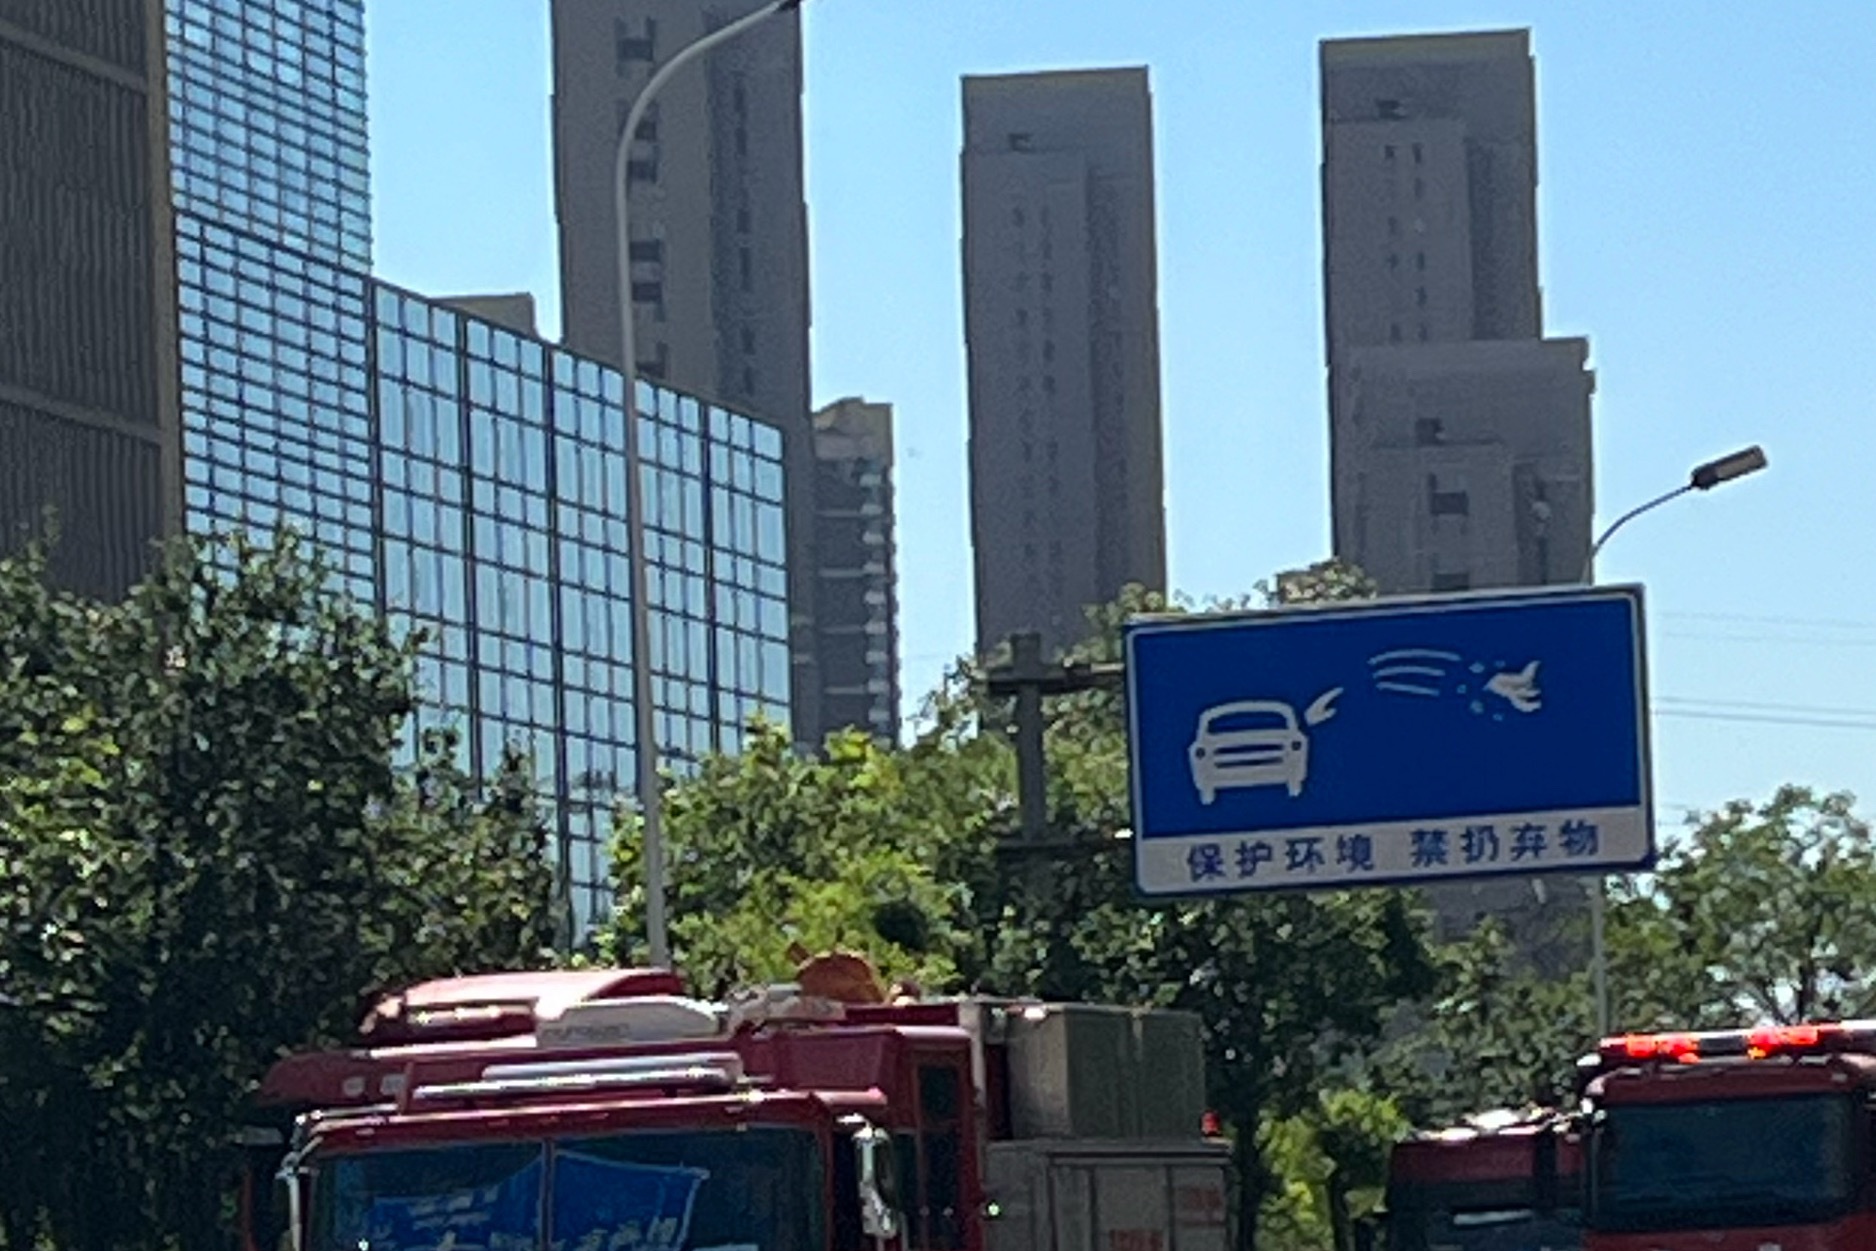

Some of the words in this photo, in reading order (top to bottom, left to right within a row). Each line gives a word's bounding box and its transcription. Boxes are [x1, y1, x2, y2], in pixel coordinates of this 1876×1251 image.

[1186, 833, 1375, 882] 保护环境
[1411, 819, 1599, 868] 禁扔弃物
